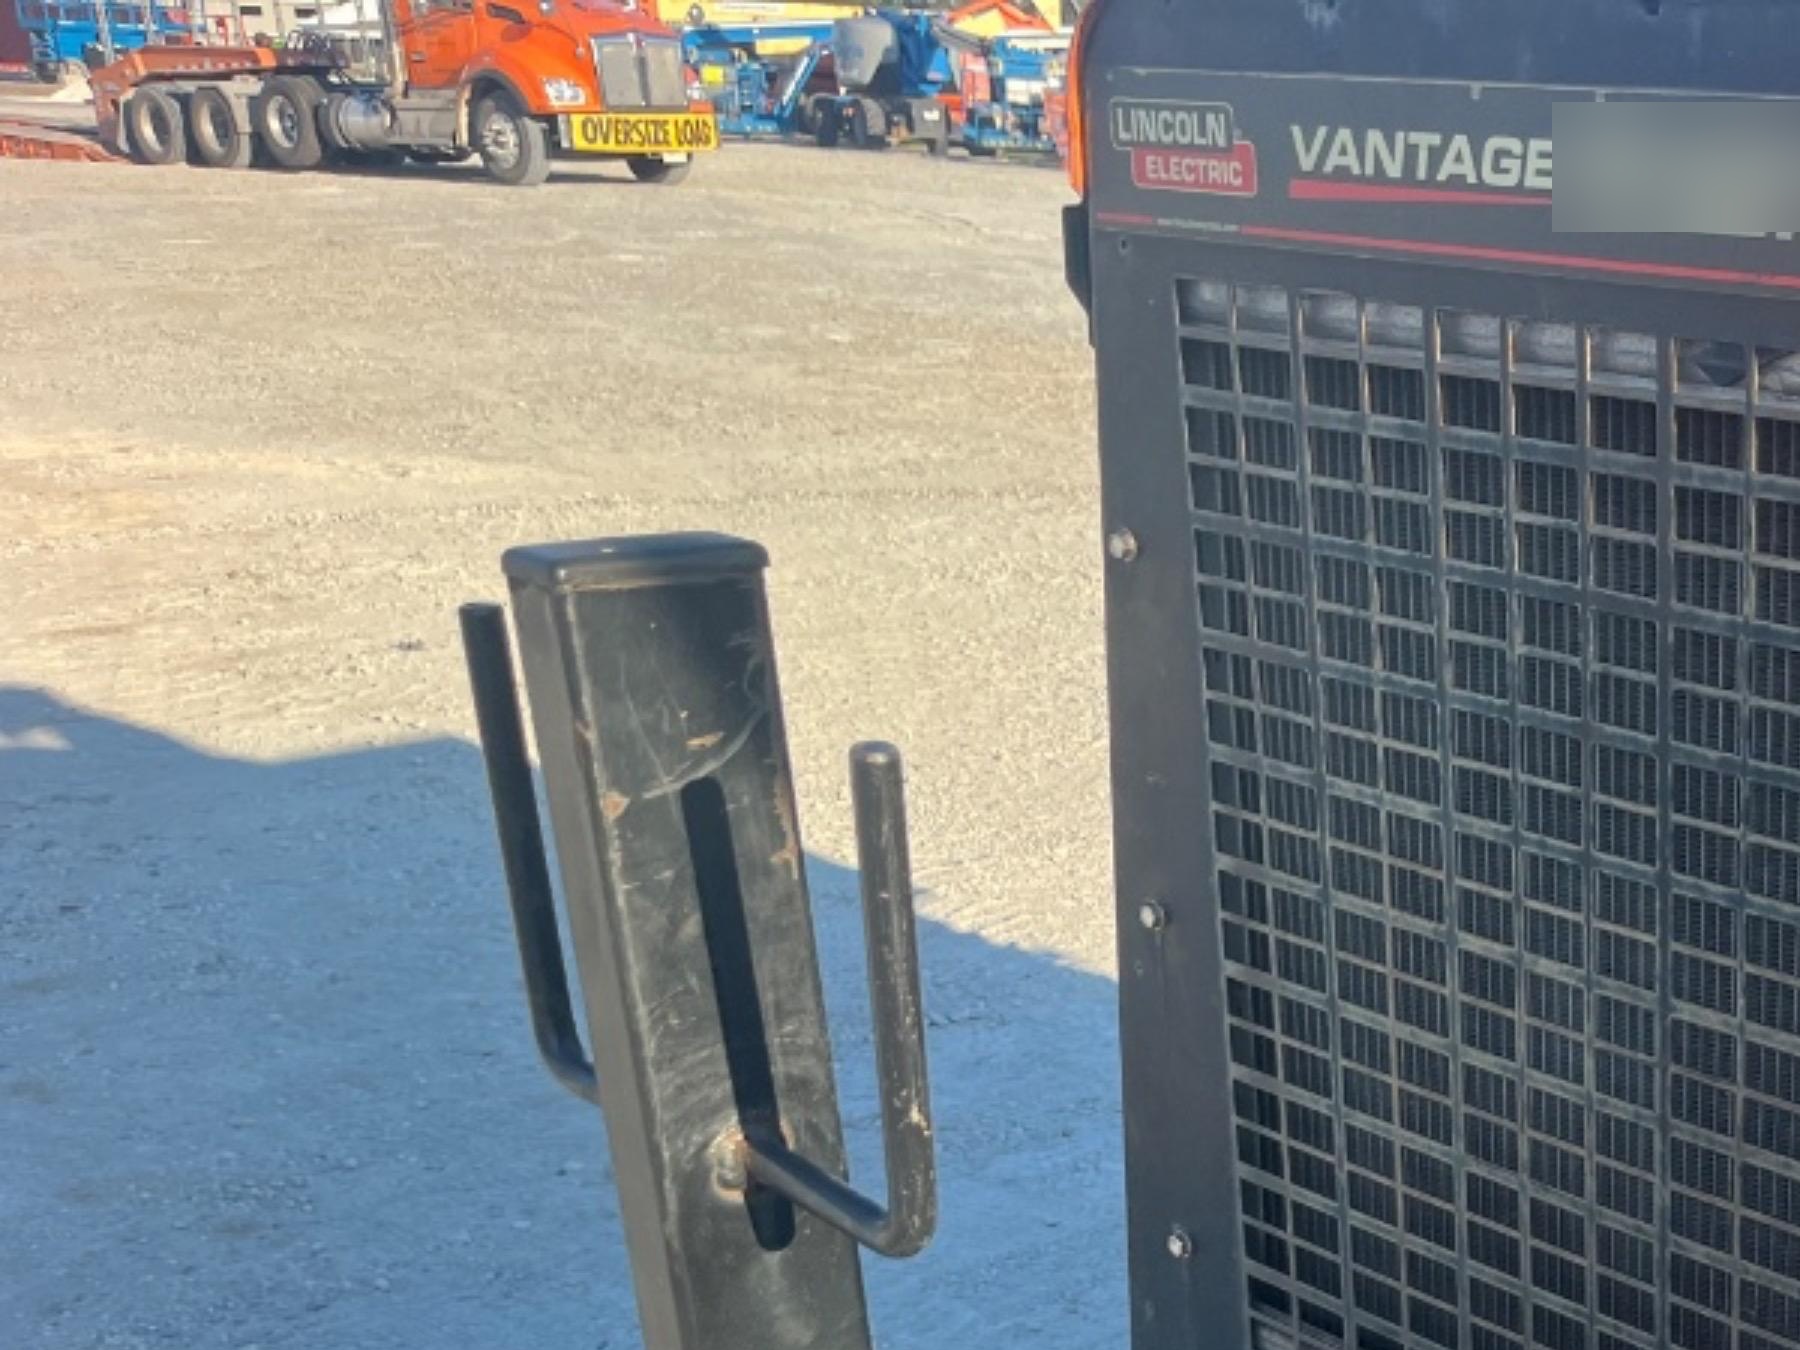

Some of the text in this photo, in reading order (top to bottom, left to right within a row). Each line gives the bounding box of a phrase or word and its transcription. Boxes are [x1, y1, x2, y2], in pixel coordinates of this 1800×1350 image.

[581, 116, 671, 147] OVERSIZE
[1115, 107, 1228, 148] LINCOLN
[1145, 154, 1243, 187] ELECTRIC
[1289, 124, 1552, 190] VANTAGE
